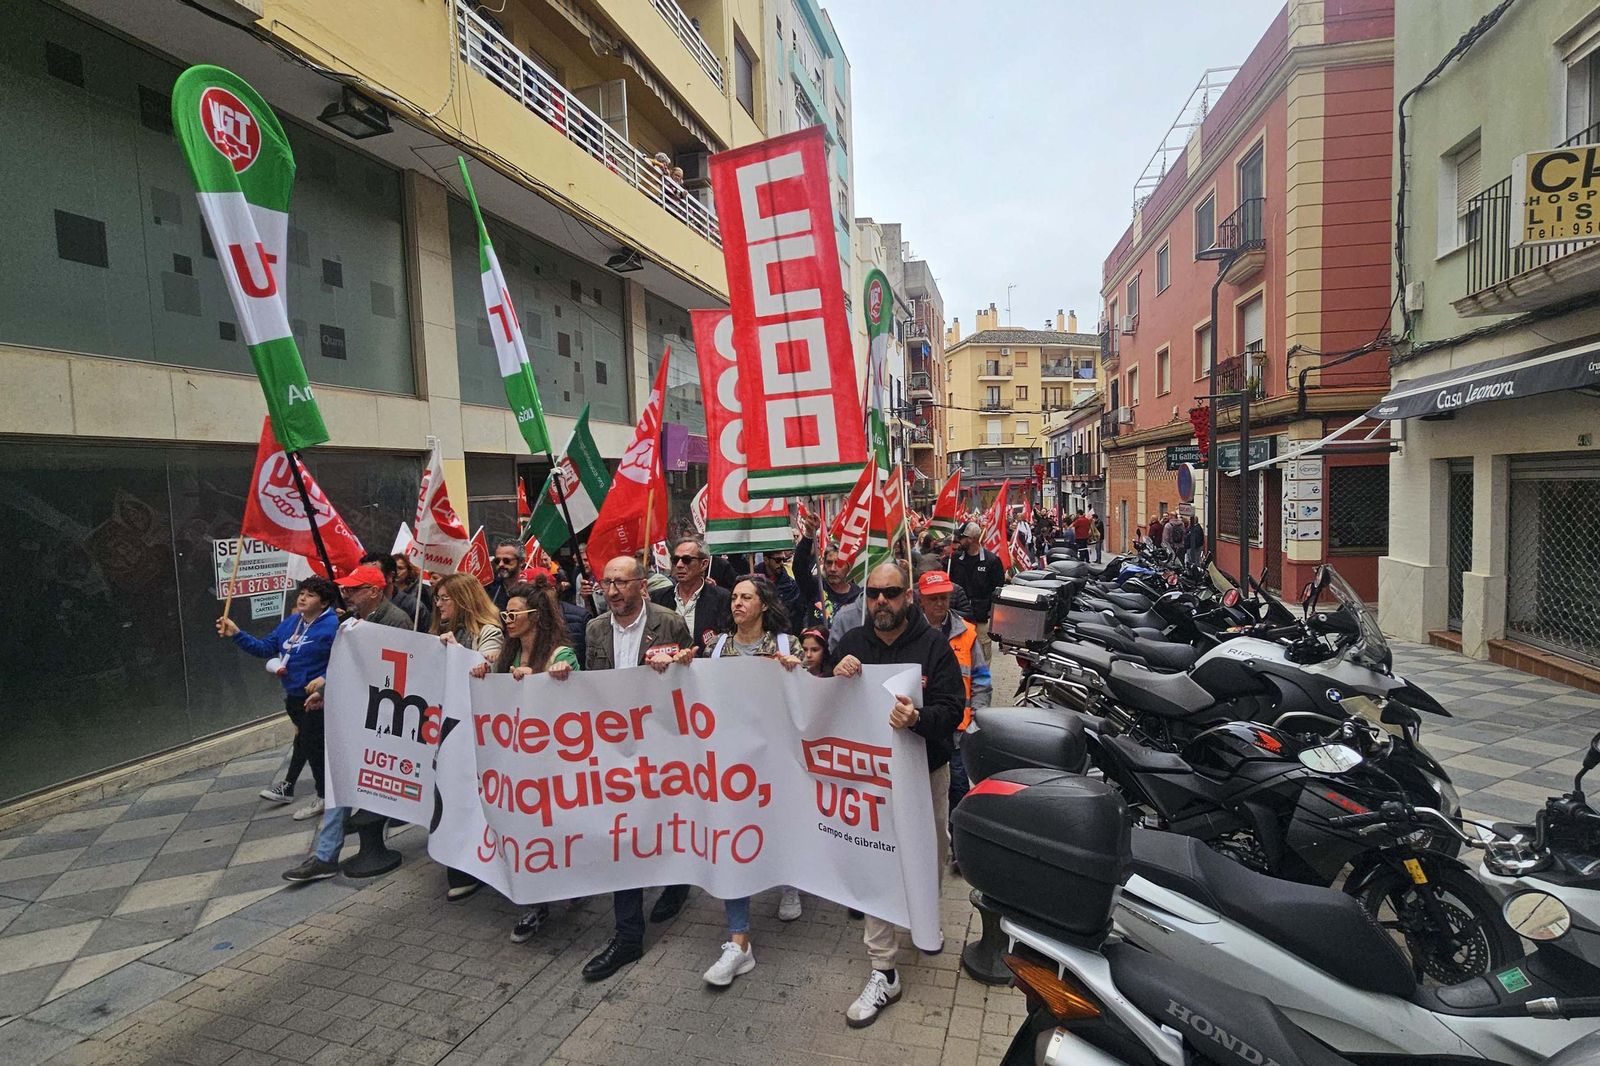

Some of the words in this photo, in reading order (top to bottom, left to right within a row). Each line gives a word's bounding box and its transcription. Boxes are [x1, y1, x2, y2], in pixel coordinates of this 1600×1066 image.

[1527, 225, 1563, 239] Tel:
[1573, 222, 1600, 235] 95
[736, 151, 840, 467] CCOO
[1437, 390, 1462, 409] Casa
[1465, 380, 1514, 403] Leonora
[218, 541, 238, 557] SE
[248, 578, 269, 593] 876
[474, 707, 652, 762] roteger
[672, 688, 715, 740] lo
[364, 748, 398, 770] UGT
[361, 772, 403, 793] CCOO
[477, 751, 771, 827] onquistado,
[816, 780, 886, 832] UGT
[609, 812, 764, 865] futuro
[818, 822, 843, 838] Campo
[843, 832, 852, 843] de
[854, 837, 896, 853] Gibraltar
